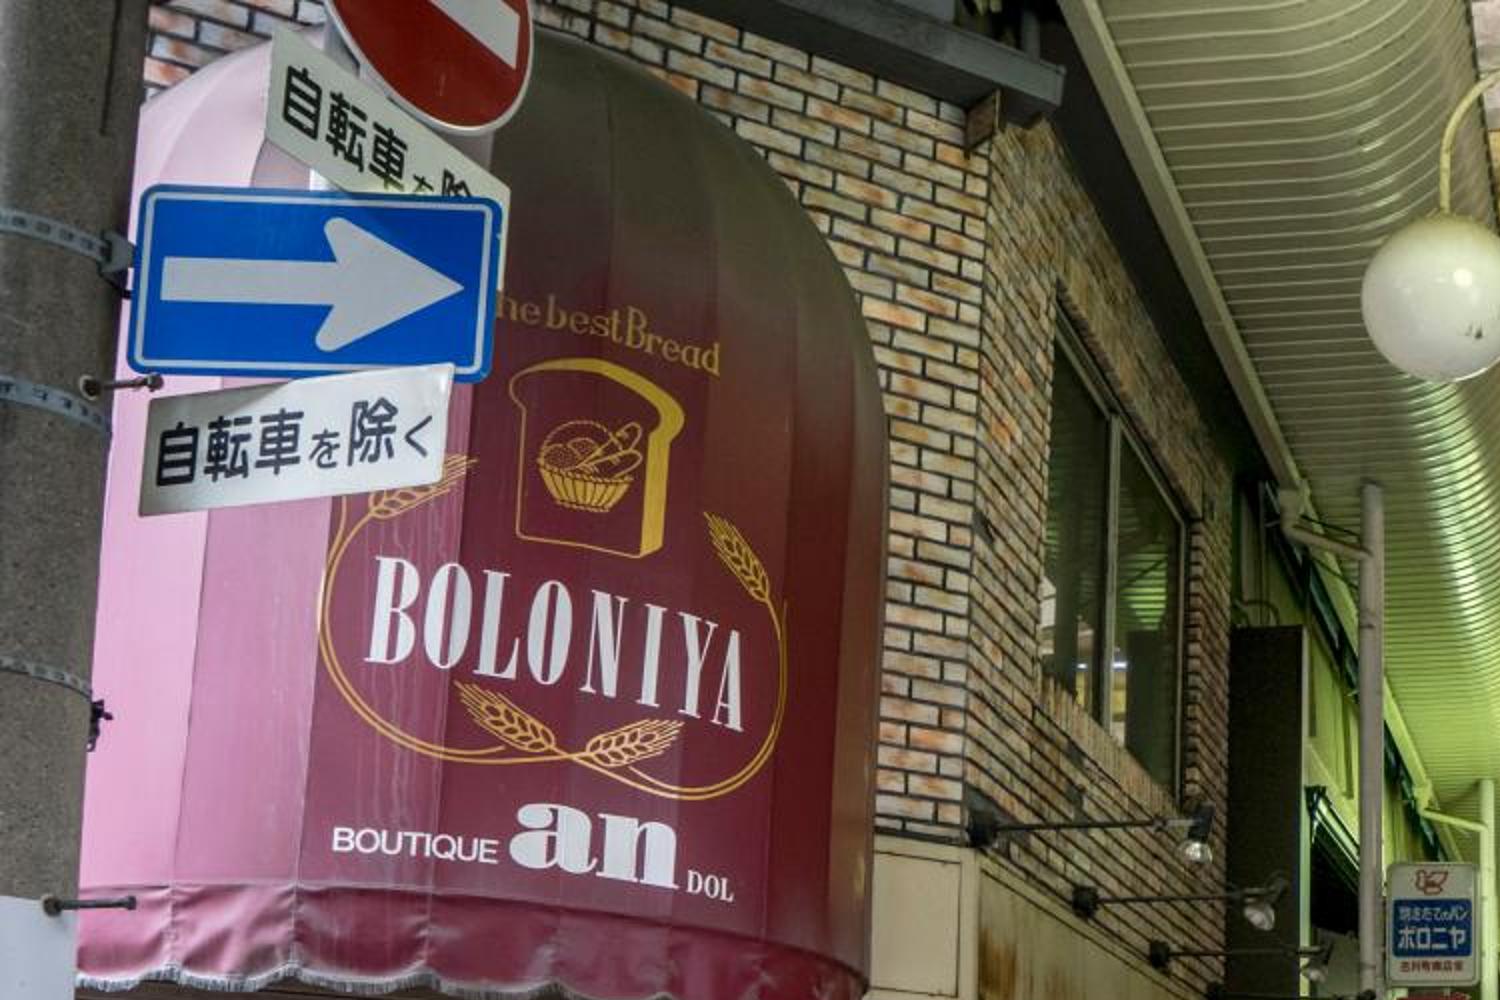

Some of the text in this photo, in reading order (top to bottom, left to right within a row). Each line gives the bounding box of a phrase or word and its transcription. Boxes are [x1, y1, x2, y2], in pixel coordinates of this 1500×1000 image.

[496, 292, 541, 326] he
[625, 304, 721, 377] Bread
[155, 397, 433, 487] 自転車を除く
[363, 555, 744, 733] BOLONIYA
[331, 801, 735, 903] BOUTIQUE an DOL
[1398, 925, 1467, 950] ボロニヤ
